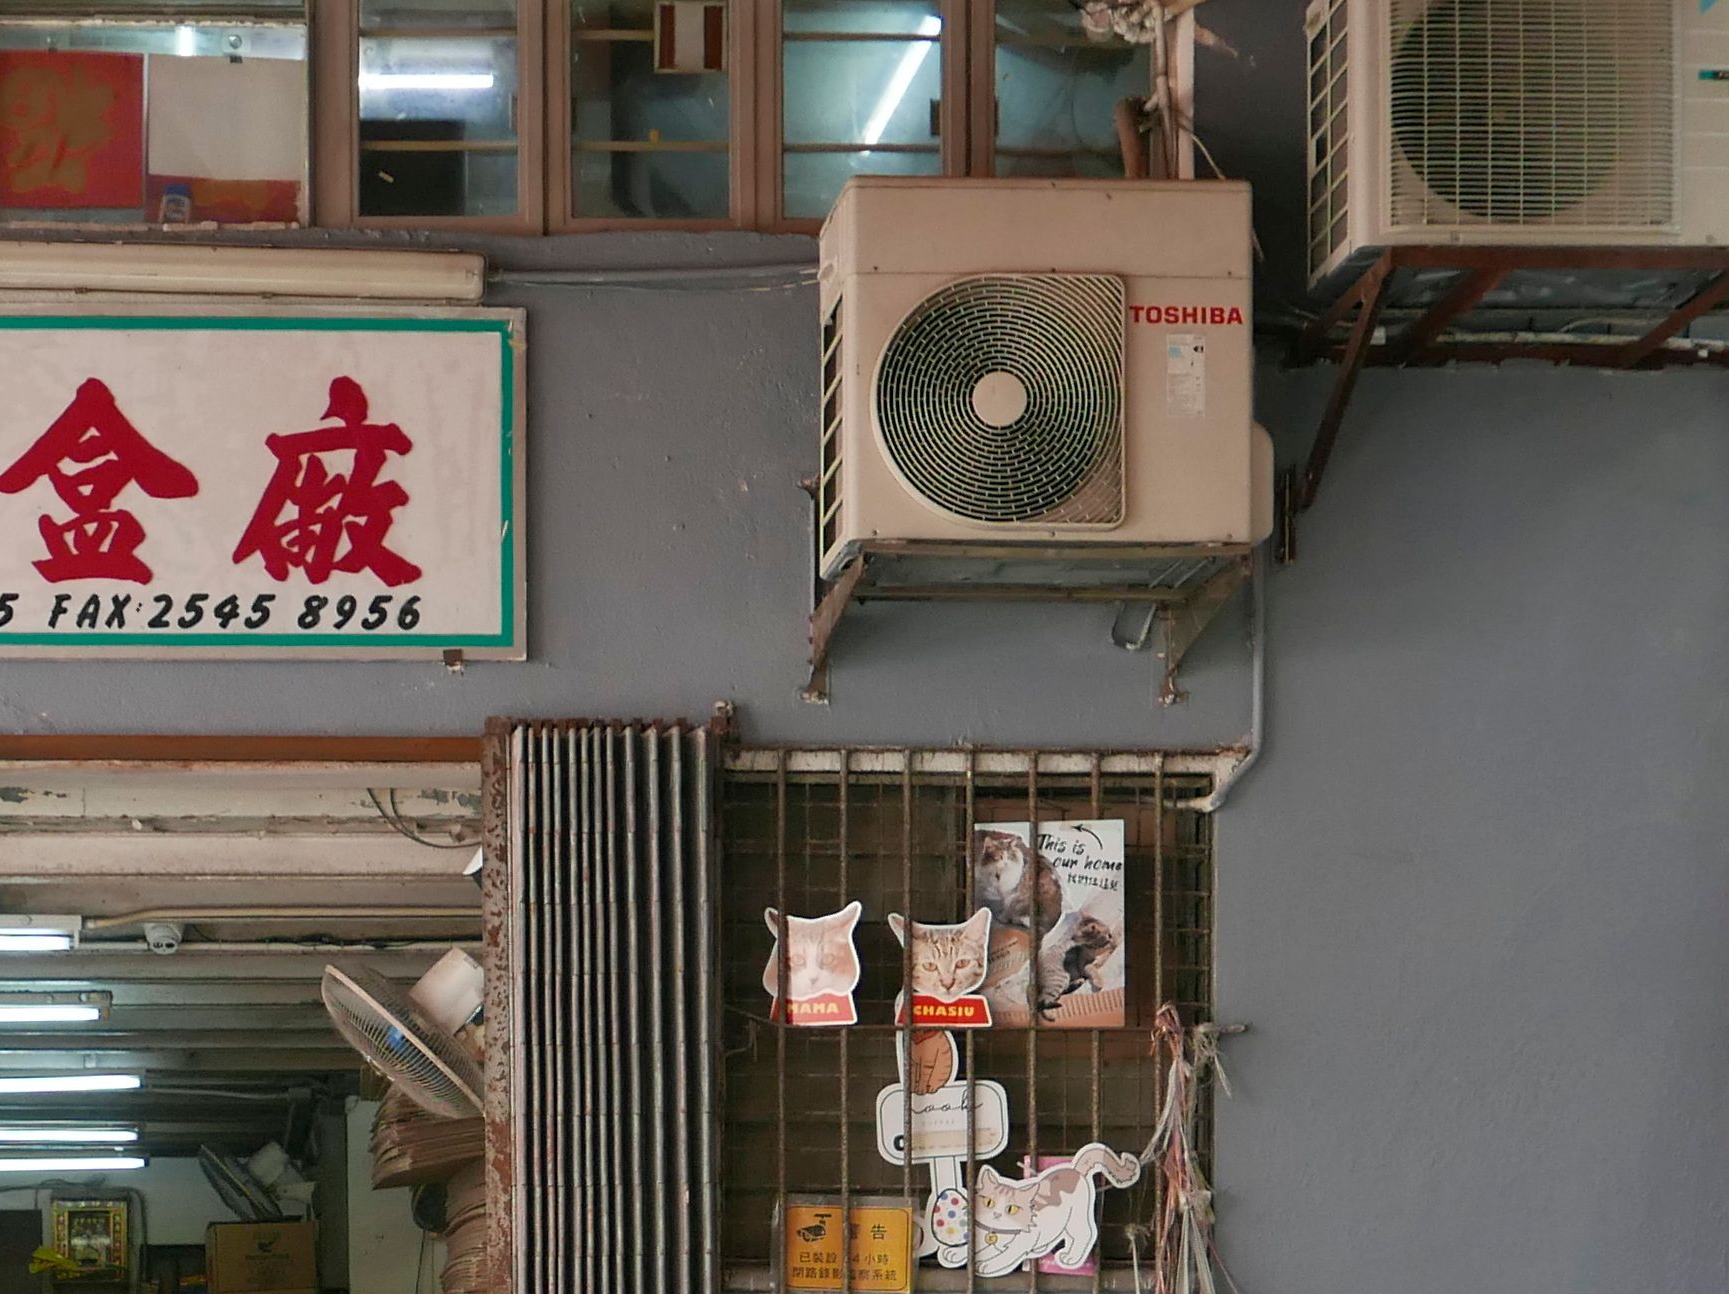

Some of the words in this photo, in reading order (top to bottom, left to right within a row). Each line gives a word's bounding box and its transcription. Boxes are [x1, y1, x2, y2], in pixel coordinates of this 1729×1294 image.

[1128, 304, 1244, 325] TOSHIBA
[1036, 833, 1067, 854] This
[1072, 840, 1087, 856] is
[1053, 857, 1079, 869] our
[1084, 854, 1123, 871] home
[912, 1004, 976, 1018] CHASIU
